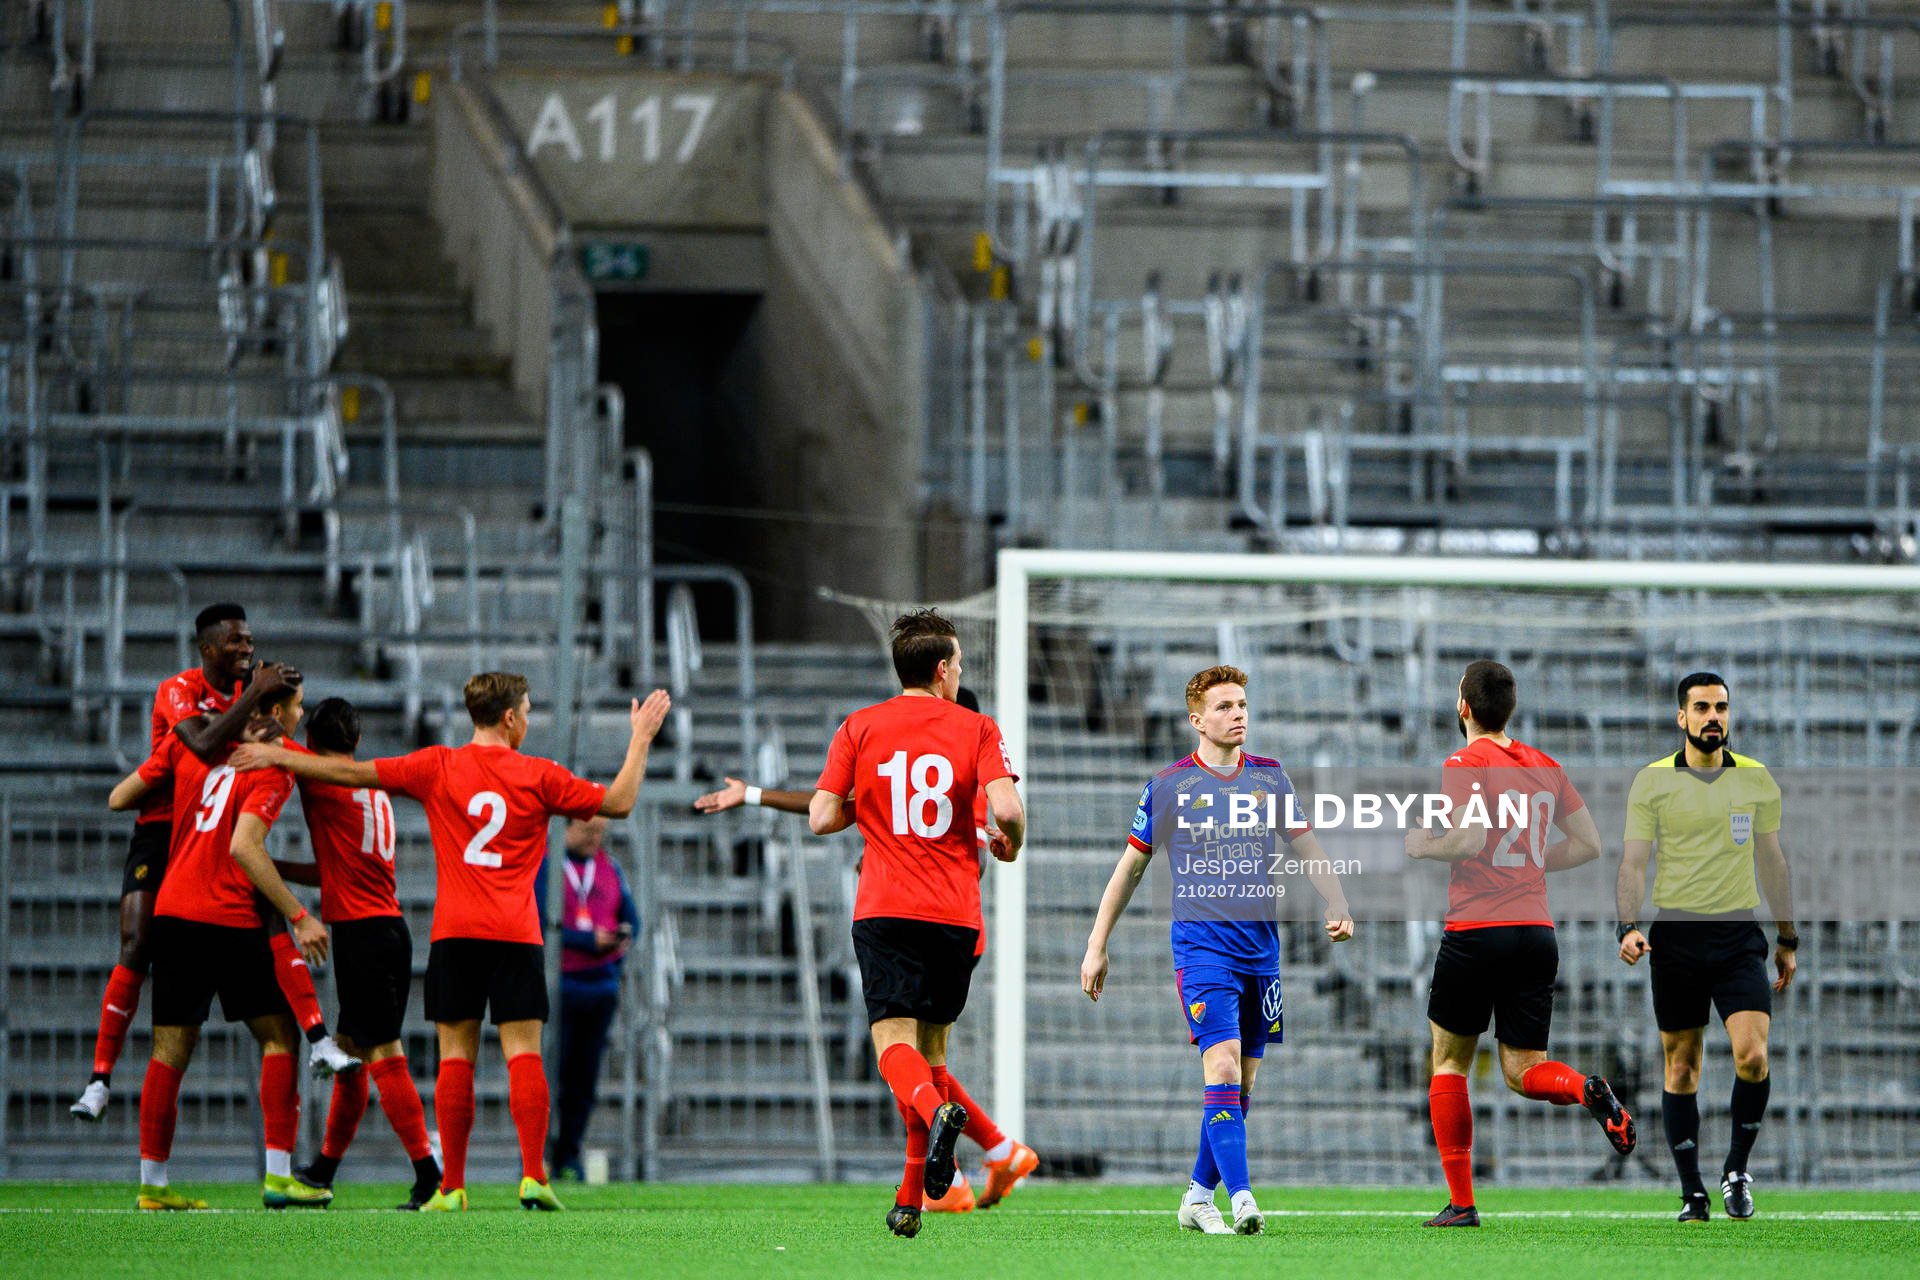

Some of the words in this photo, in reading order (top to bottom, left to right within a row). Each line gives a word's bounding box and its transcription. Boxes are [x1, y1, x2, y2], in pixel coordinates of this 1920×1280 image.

[527, 93, 717, 163] A117
[195, 765, 236, 832] 9
[352, 788, 396, 861] 10
[464, 791, 507, 868] 2
[877, 750, 954, 839] 18
[1492, 789, 1555, 869] 20
[1204, 841, 1263, 861] Finans
